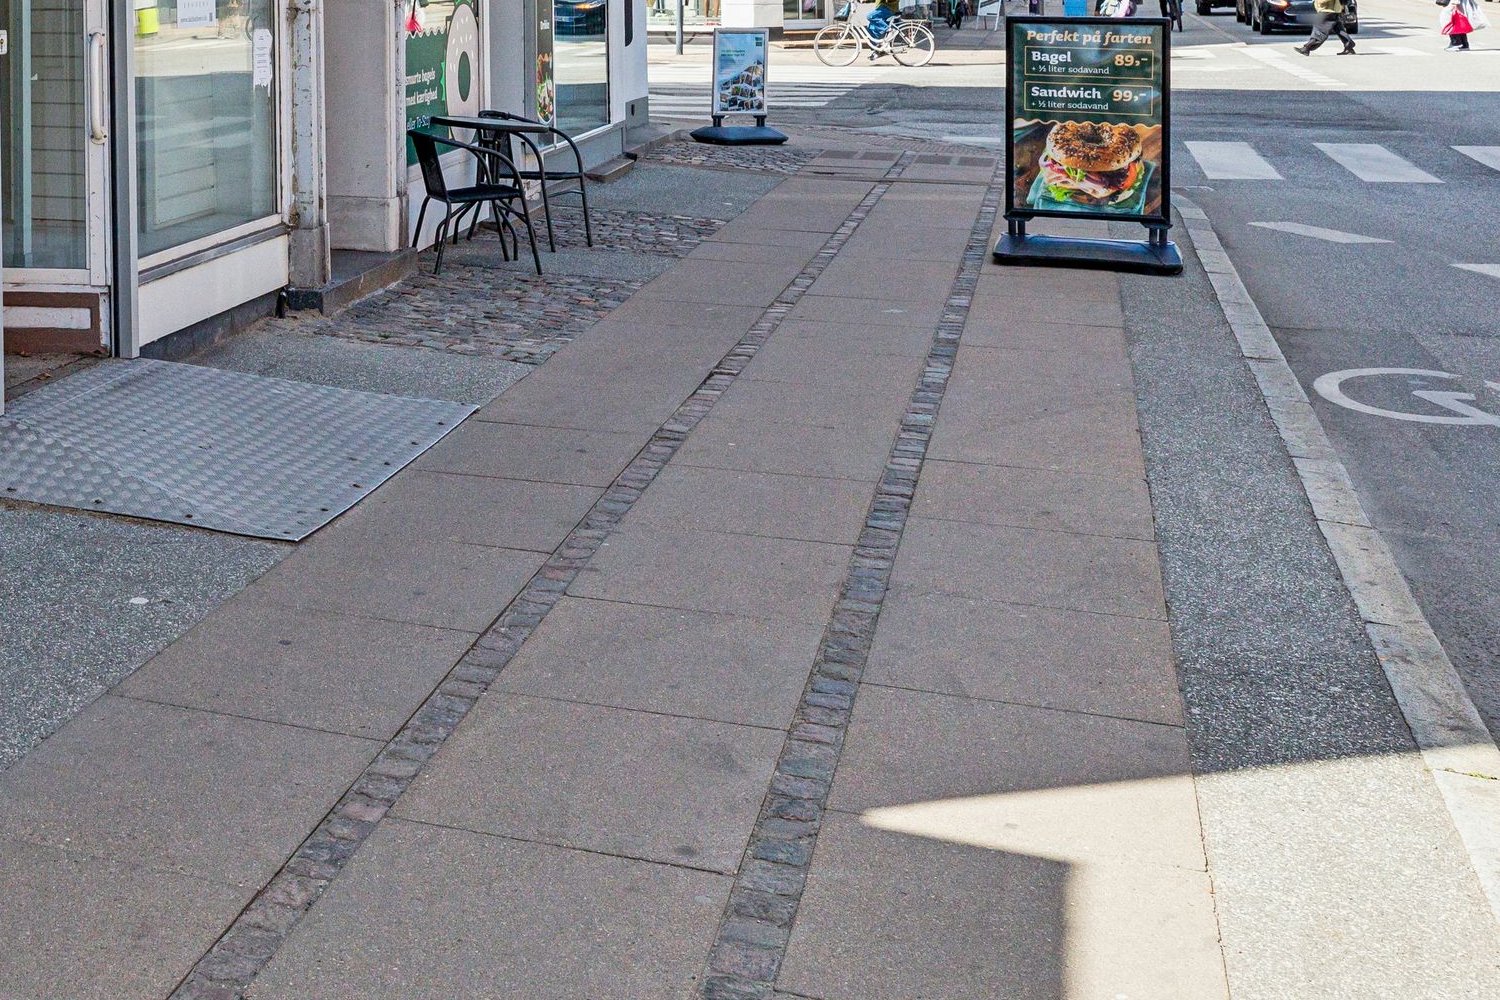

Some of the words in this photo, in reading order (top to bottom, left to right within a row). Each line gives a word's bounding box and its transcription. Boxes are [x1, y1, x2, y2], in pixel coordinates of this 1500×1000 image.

[1027, 30, 1079, 45] Perfekt
[1082, 31, 1101, 45] på
[1103, 31, 1152, 45] farten
[1031, 51, 1072, 65] Bagel
[1114, 54, 1148, 67] 89,-
[1048, 65, 1066, 73] liter
[1068, 66, 1110, 75] sodavand
[1031, 86, 1101, 99] Sandwich
[1112, 89, 1147, 102] 99,-
[1047, 101, 1065, 109] liter
[1067, 102, 1109, 110] sodavand
